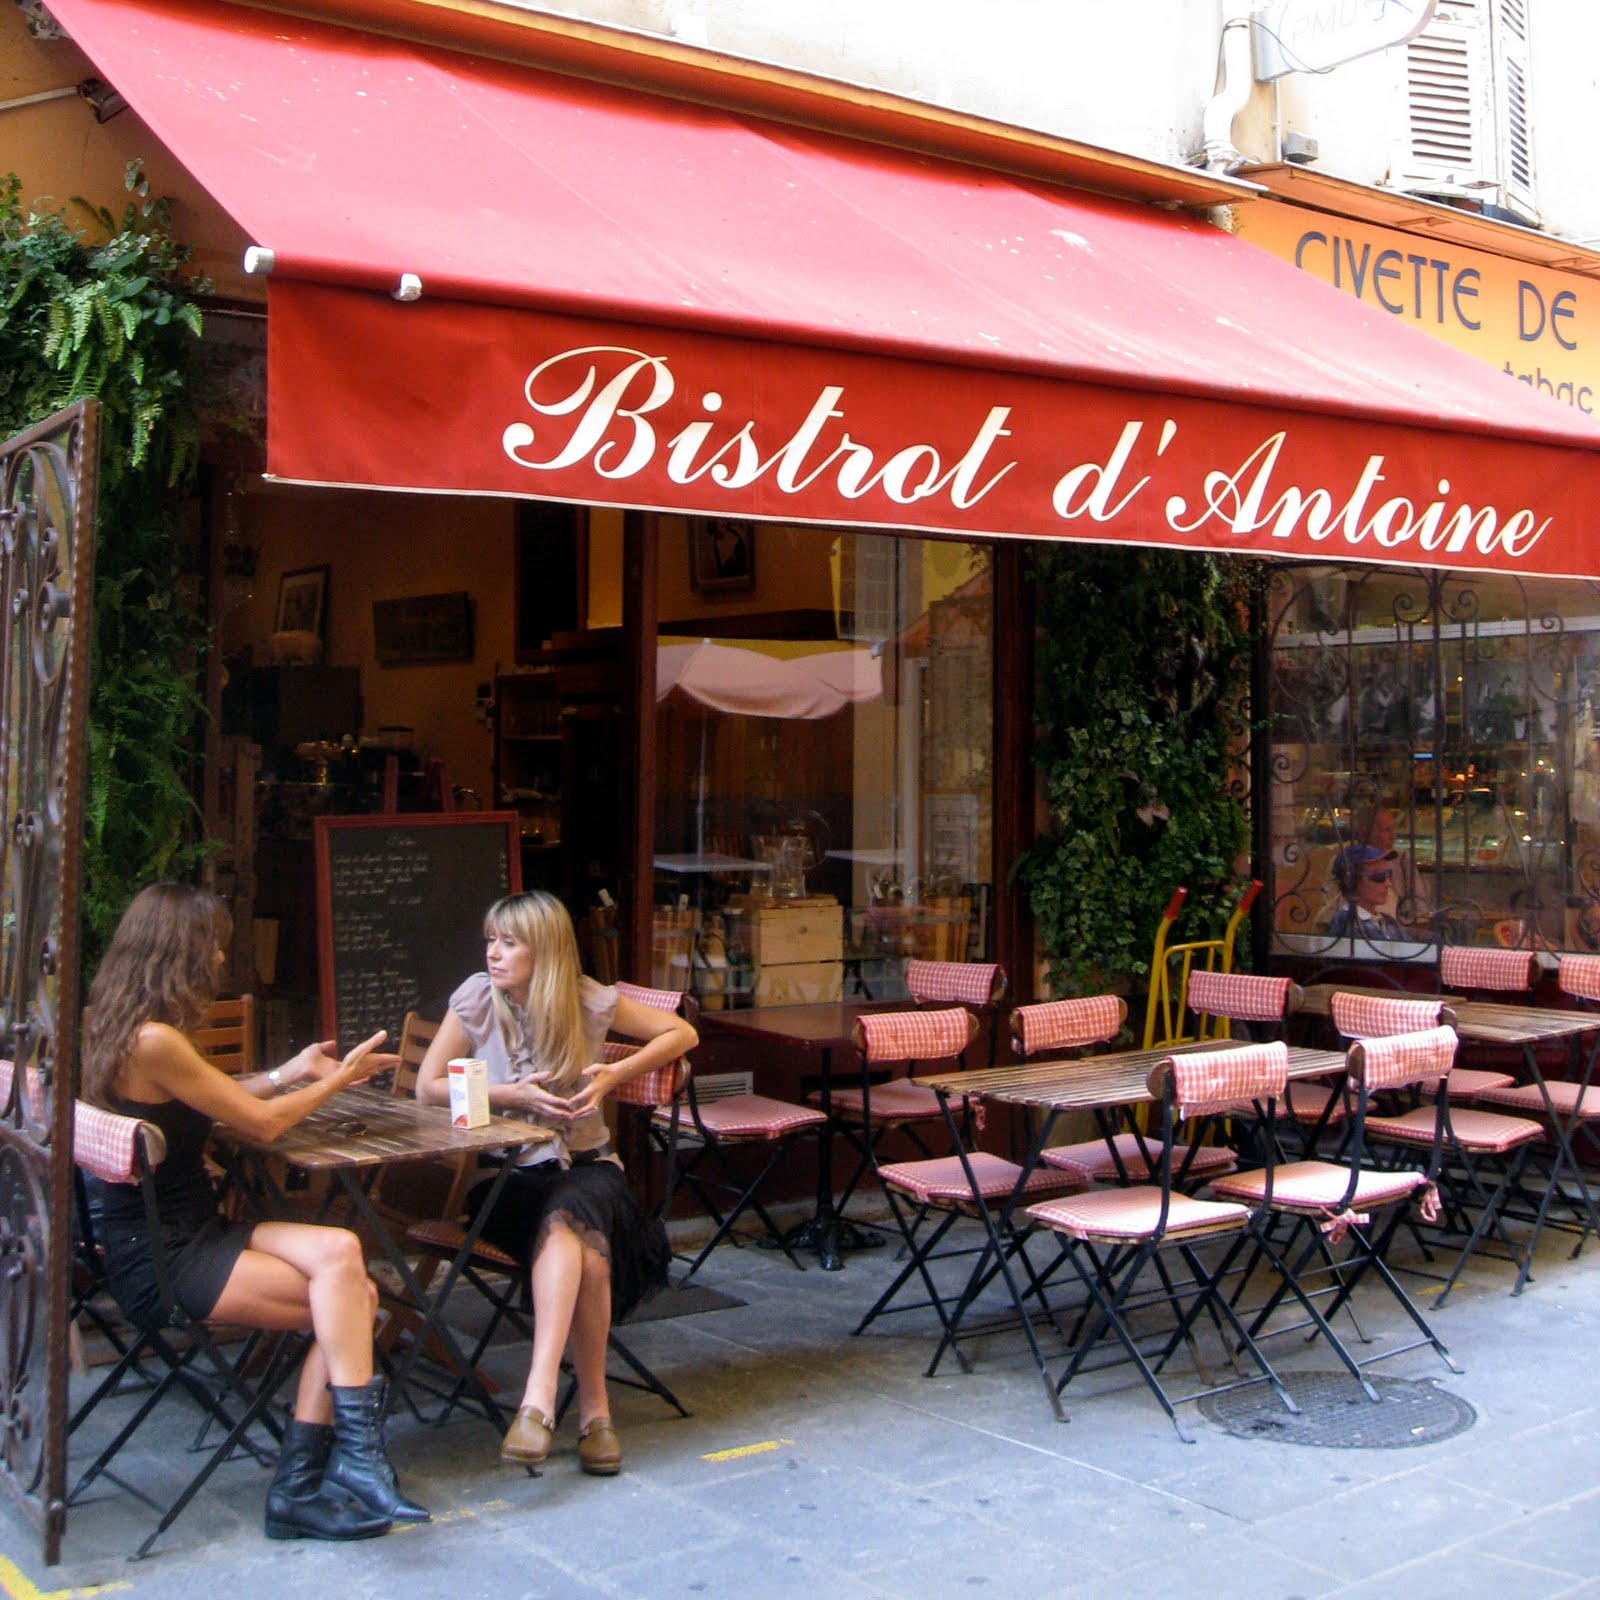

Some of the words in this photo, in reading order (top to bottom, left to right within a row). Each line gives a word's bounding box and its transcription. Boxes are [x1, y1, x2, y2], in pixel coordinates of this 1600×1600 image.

[1295, 231, 1481, 331] CIVETTE
[1518, 280, 1577, 351] DE
[502, 346, 1018, 510] Bistrot
